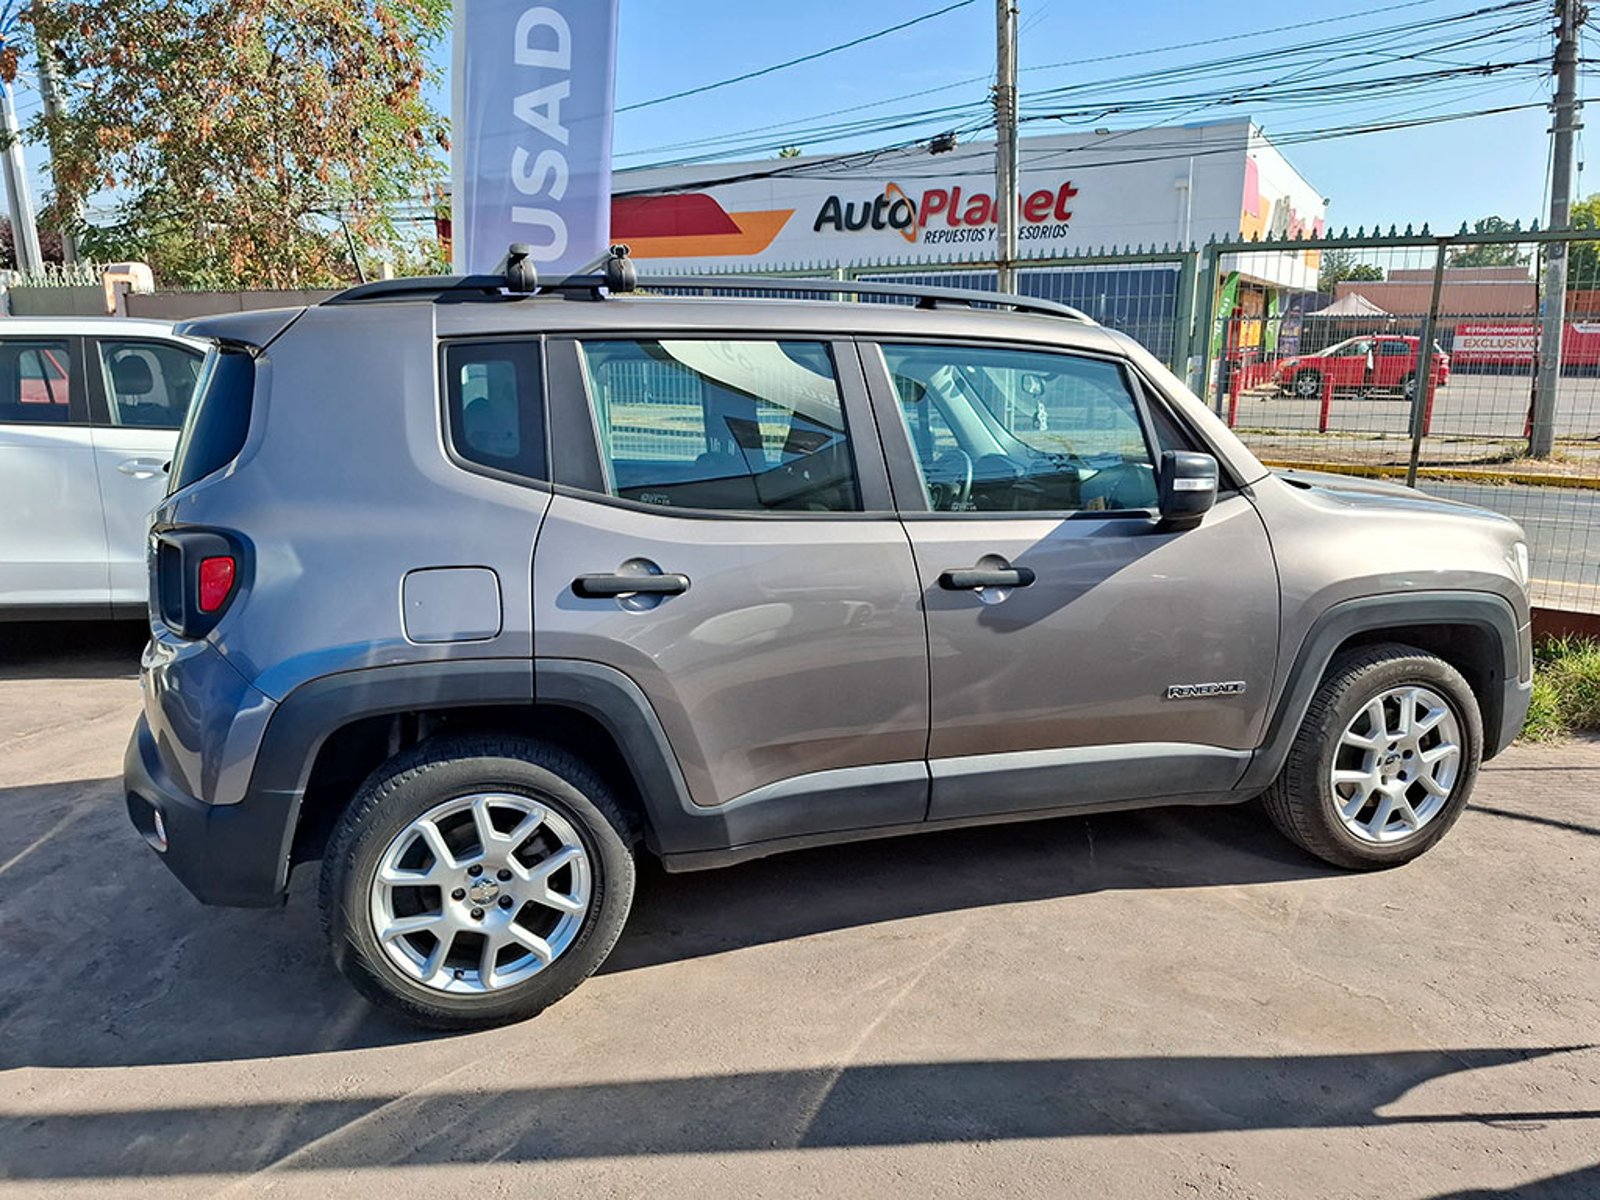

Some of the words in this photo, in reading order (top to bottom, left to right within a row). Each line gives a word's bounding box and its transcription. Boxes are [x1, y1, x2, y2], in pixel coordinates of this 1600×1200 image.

[924, 228, 986, 244] REPUESTOS
[988, 227, 996, 241] Y
[998, 224, 1069, 241] ESORIOS
[1167, 681, 1246, 699] RENEGADE
